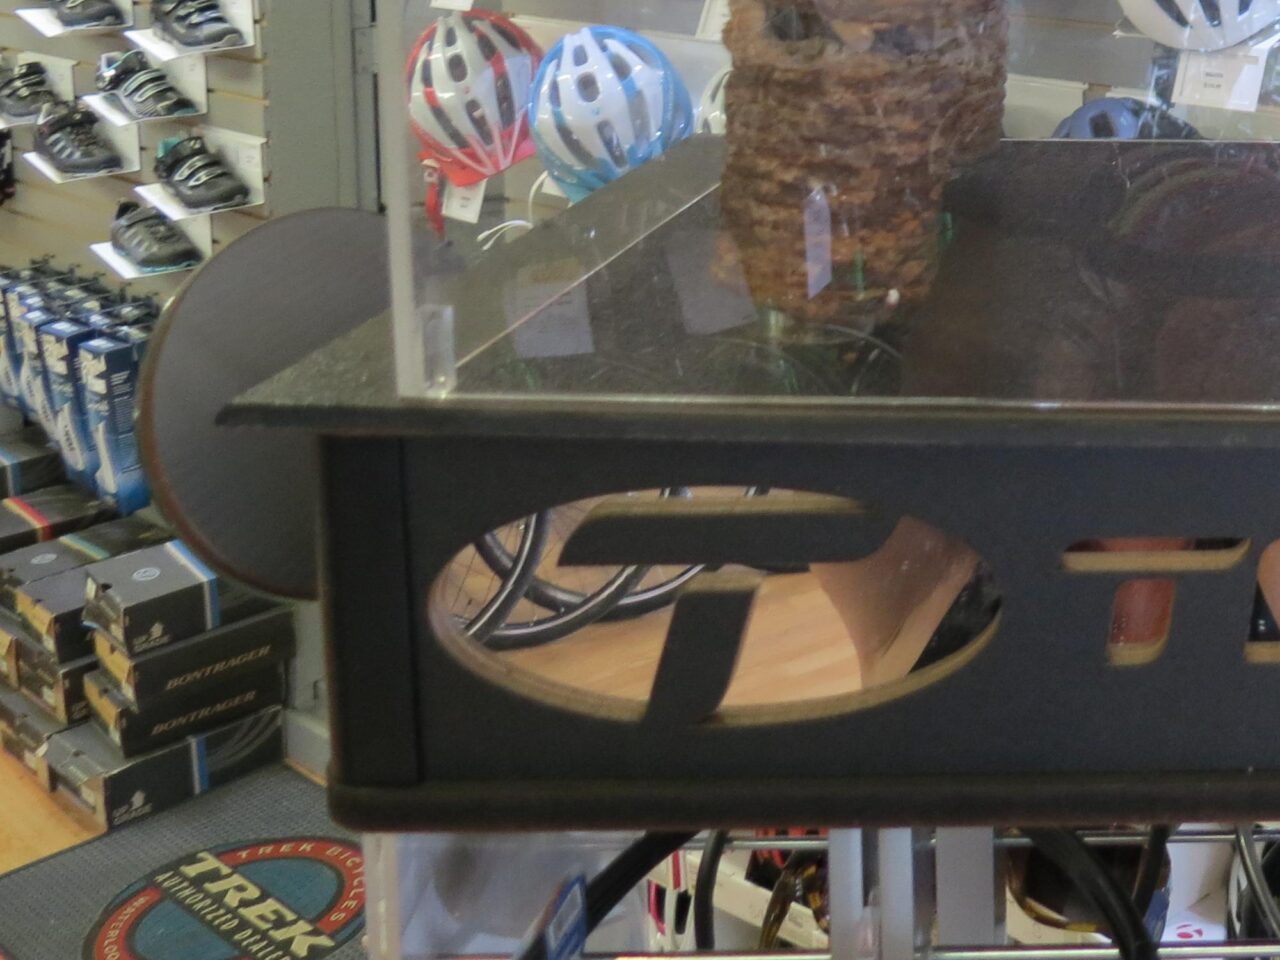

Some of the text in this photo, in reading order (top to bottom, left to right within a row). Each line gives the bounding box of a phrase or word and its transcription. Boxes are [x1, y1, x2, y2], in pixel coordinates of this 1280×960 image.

[165, 645, 272, 690] BONTRAGER
[151, 691, 256, 735] BONTRAGER
[153, 871, 240, 930] AUTHORIZED
[180, 851, 335, 958] TREK
[236, 842, 365, 922] TREK BICYCLES
